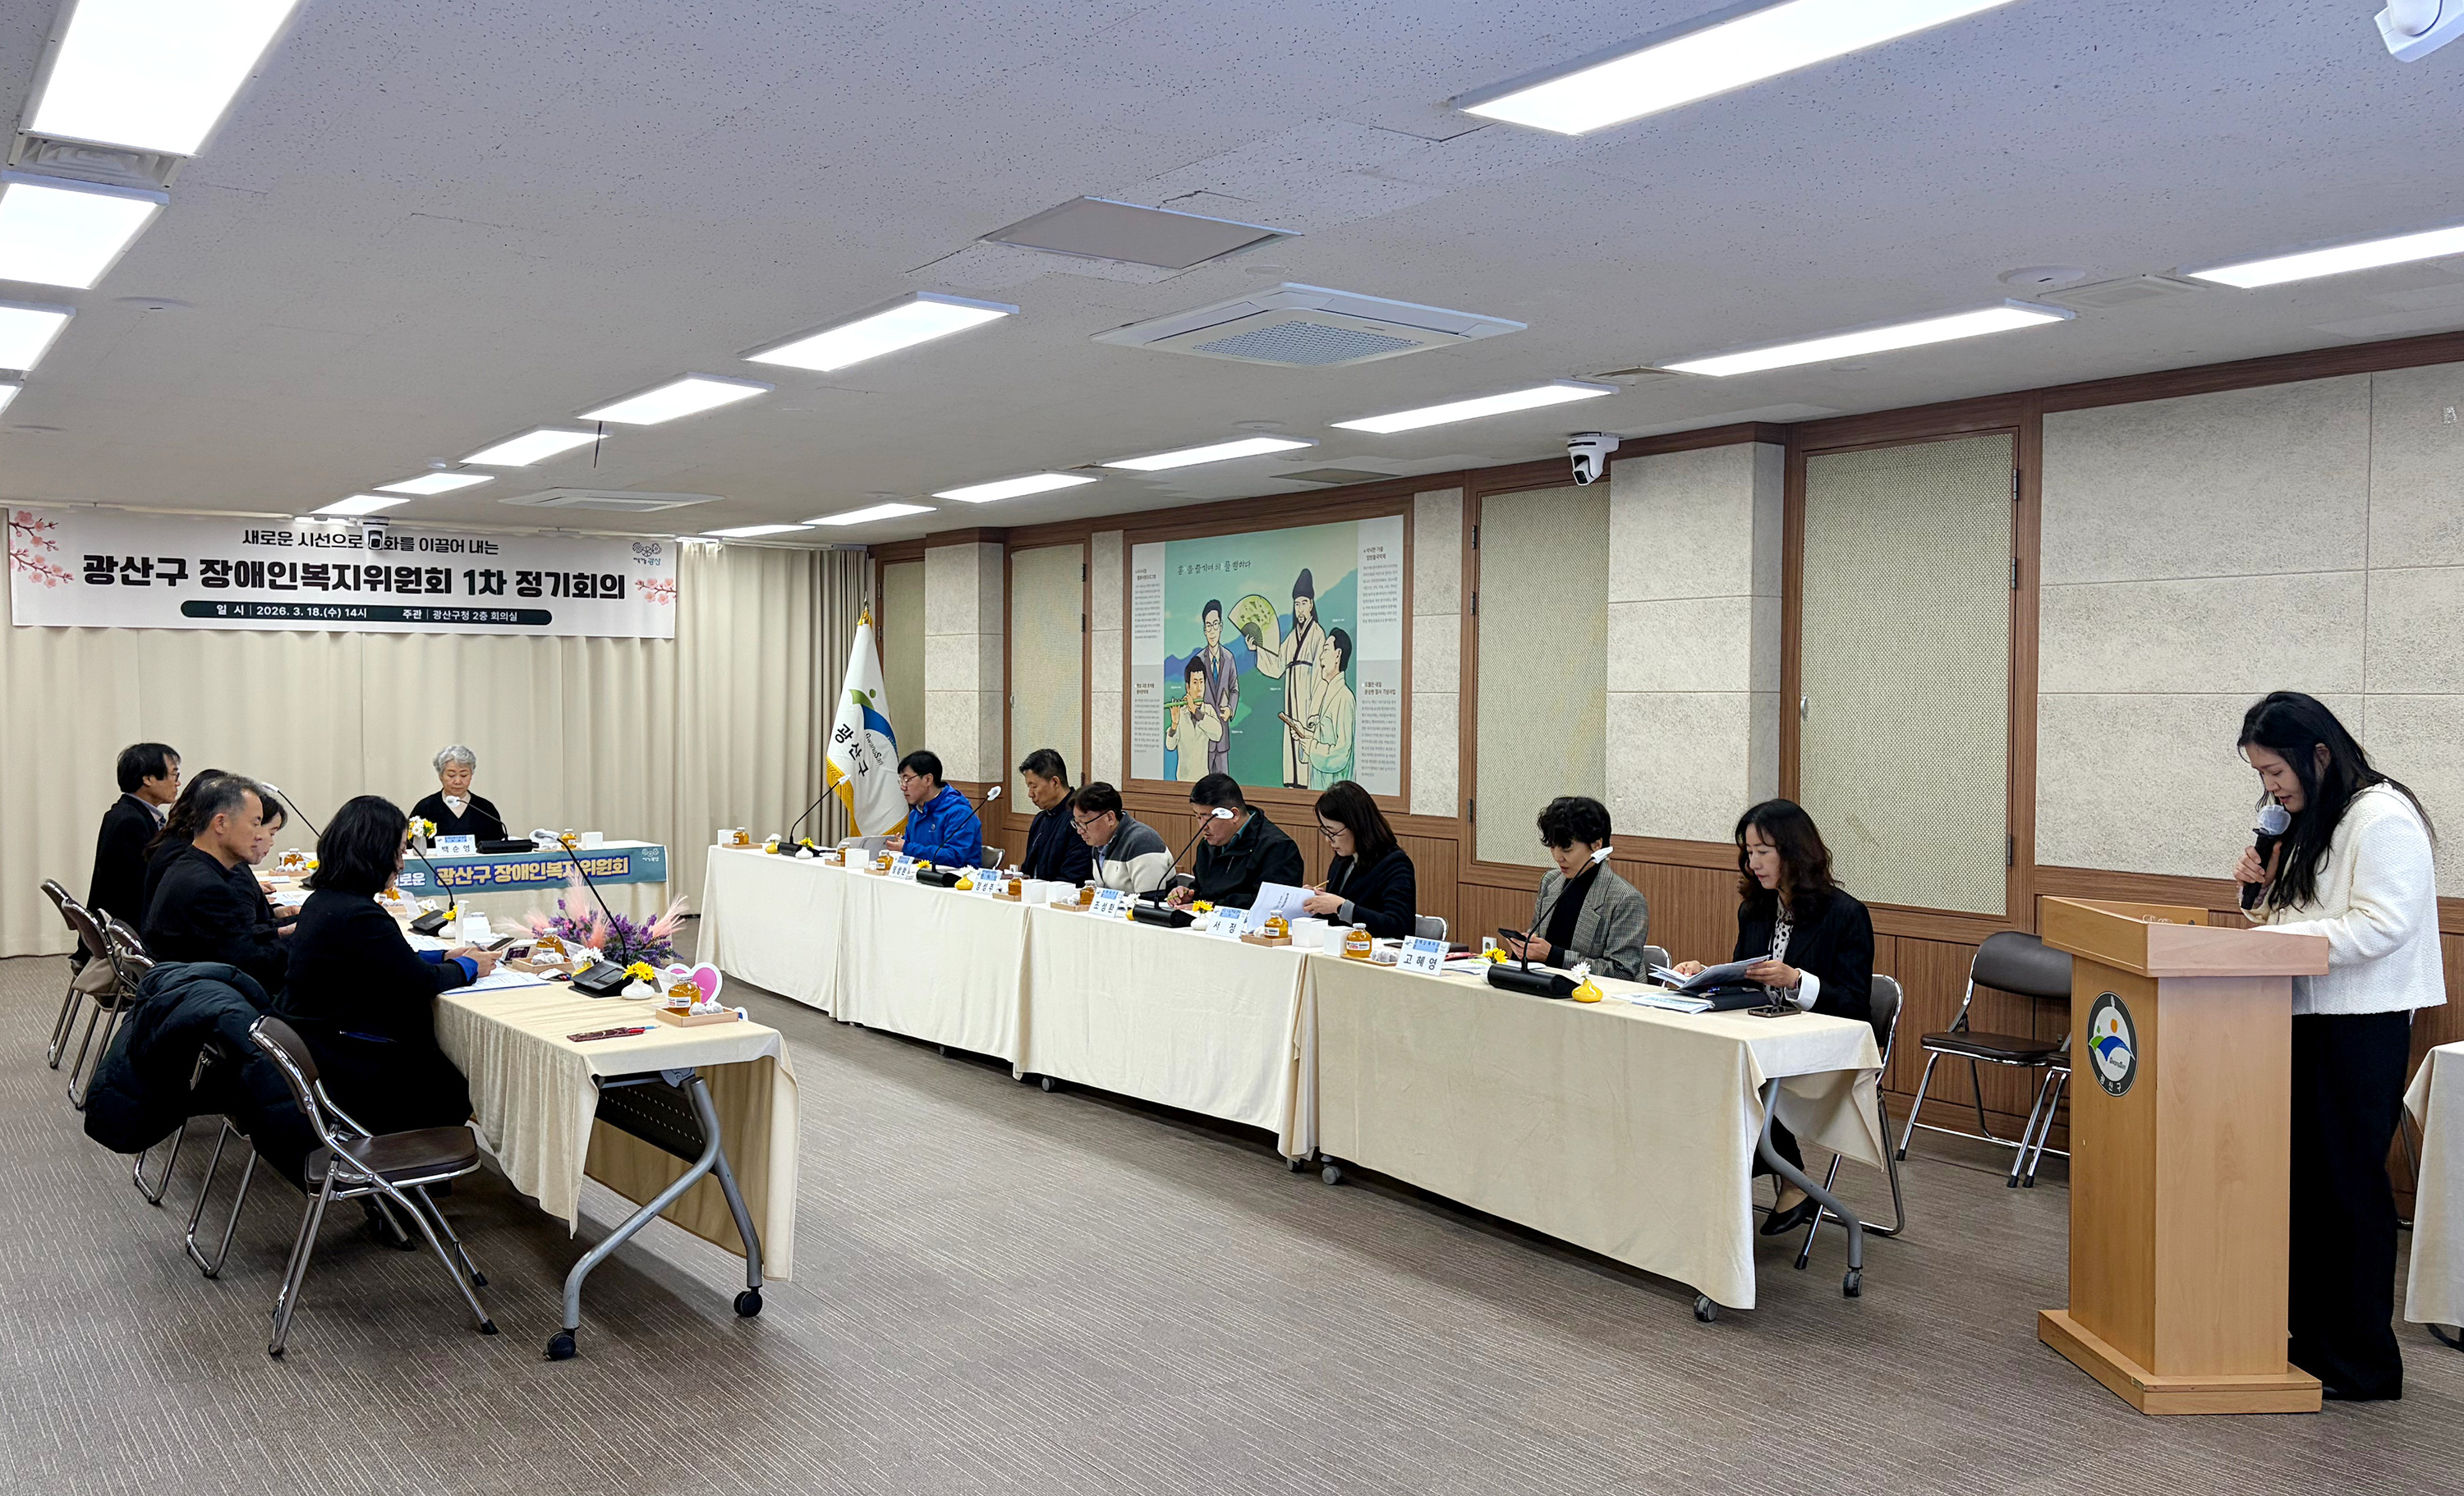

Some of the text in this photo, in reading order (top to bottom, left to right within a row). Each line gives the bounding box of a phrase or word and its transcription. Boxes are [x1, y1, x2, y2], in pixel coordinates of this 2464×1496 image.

[242, 529, 499, 555] 새로운 시선으로 화를 이끌어 내는
[83, 554, 626, 599] 광산구 장애인복지위원회 1차 정기회의
[256, 606, 290, 617] 2026.
[293, 607, 304, 617] 3.
[307, 607, 342, 618] 18.(수)
[344, 608, 367, 620] 14시
[402, 609, 422, 620] 주관
[433, 609, 470, 622] 광산구청
[472, 611, 488, 622] 2층
[490, 611, 517, 622] 회의실
[436, 865, 491, 886] 광산구
[494, 856, 629, 883] 장애인복지위원회
